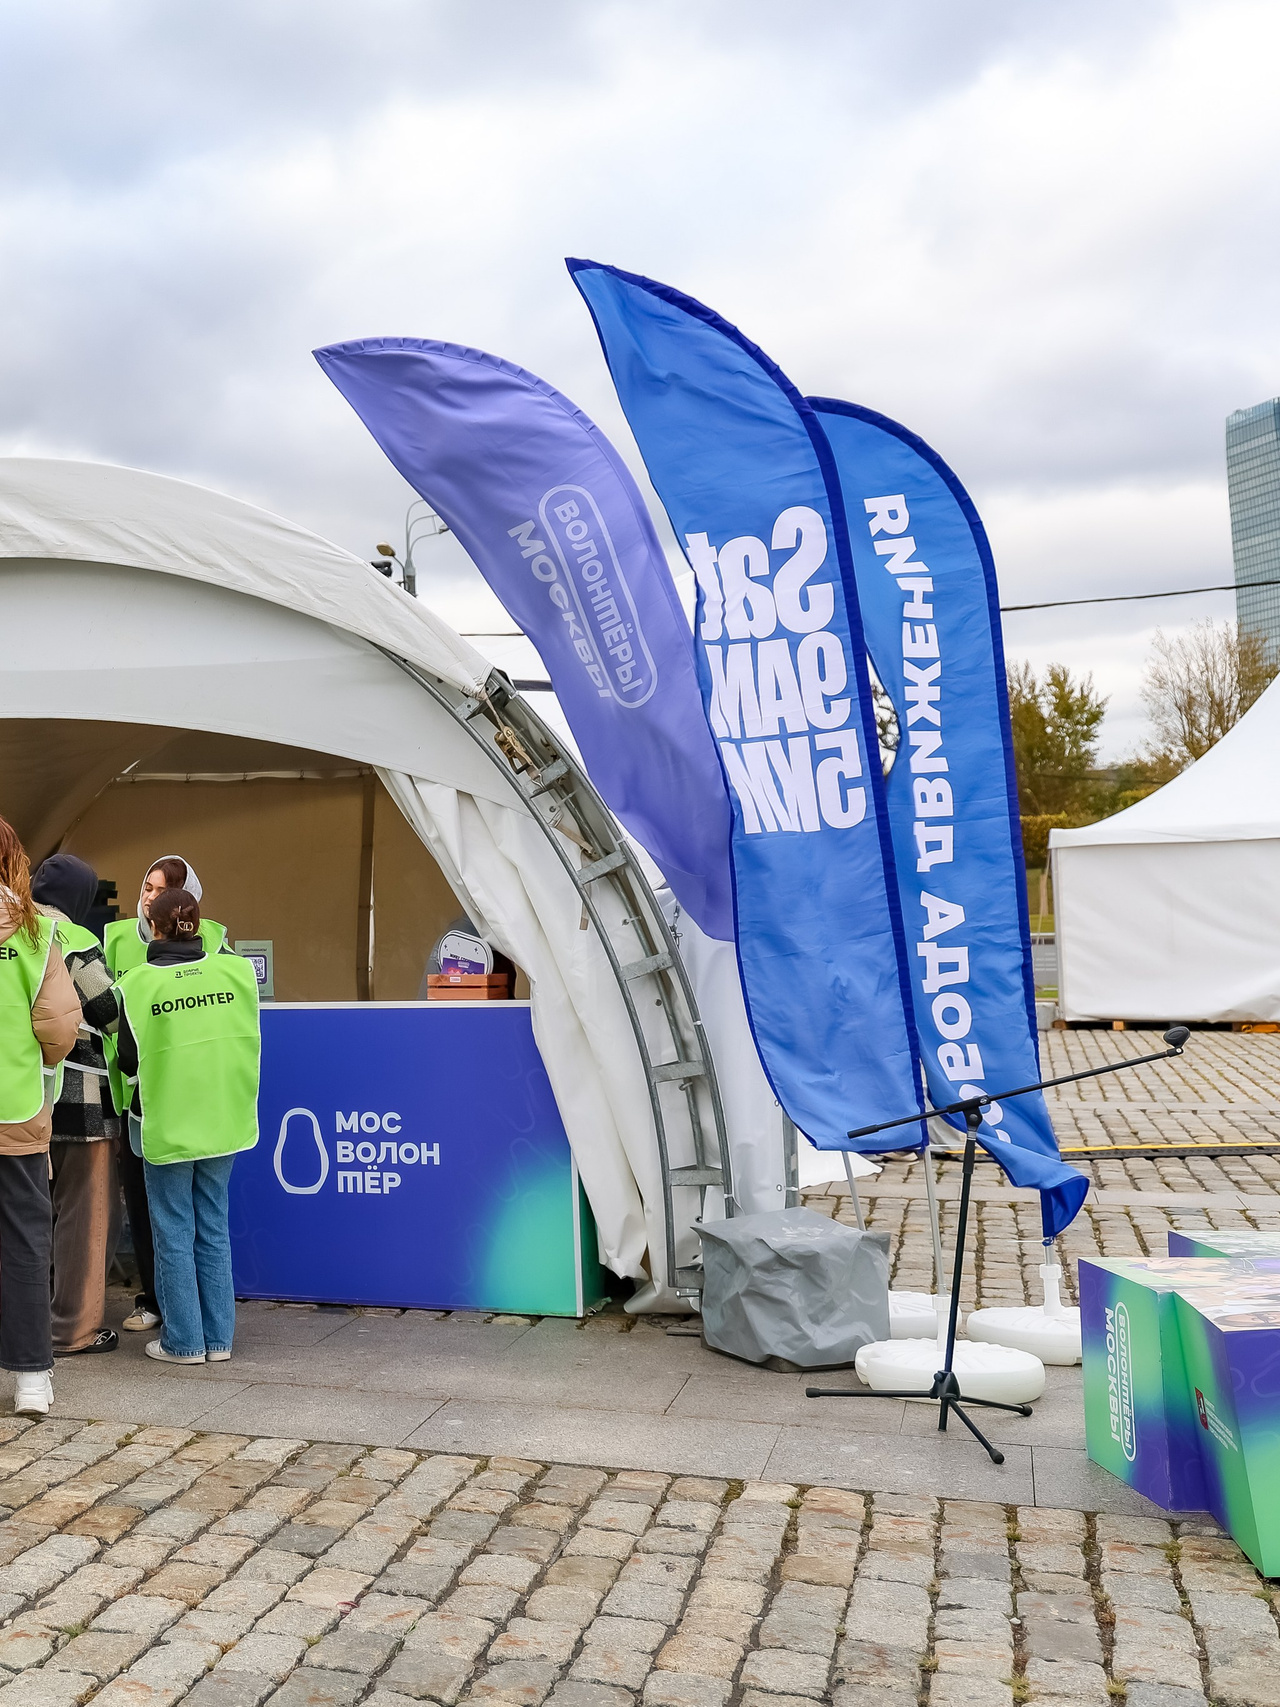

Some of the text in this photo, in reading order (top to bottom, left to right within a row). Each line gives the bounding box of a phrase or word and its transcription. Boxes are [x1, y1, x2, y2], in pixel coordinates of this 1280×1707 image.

[507, 519, 611, 698] МОСКВЫ
[554, 499, 643, 693] ВОЛОНТЁРЫ
[151, 992, 235, 1016] ВОЛОНТЕР
[335, 1111, 402, 1134] МОС
[336, 1141, 440, 1165] ВОЛОН
[1105, 1307, 1120, 1442] МОСКВЫ
[1119, 1314, 1132, 1449] ВОЛОНТЁРЫ
